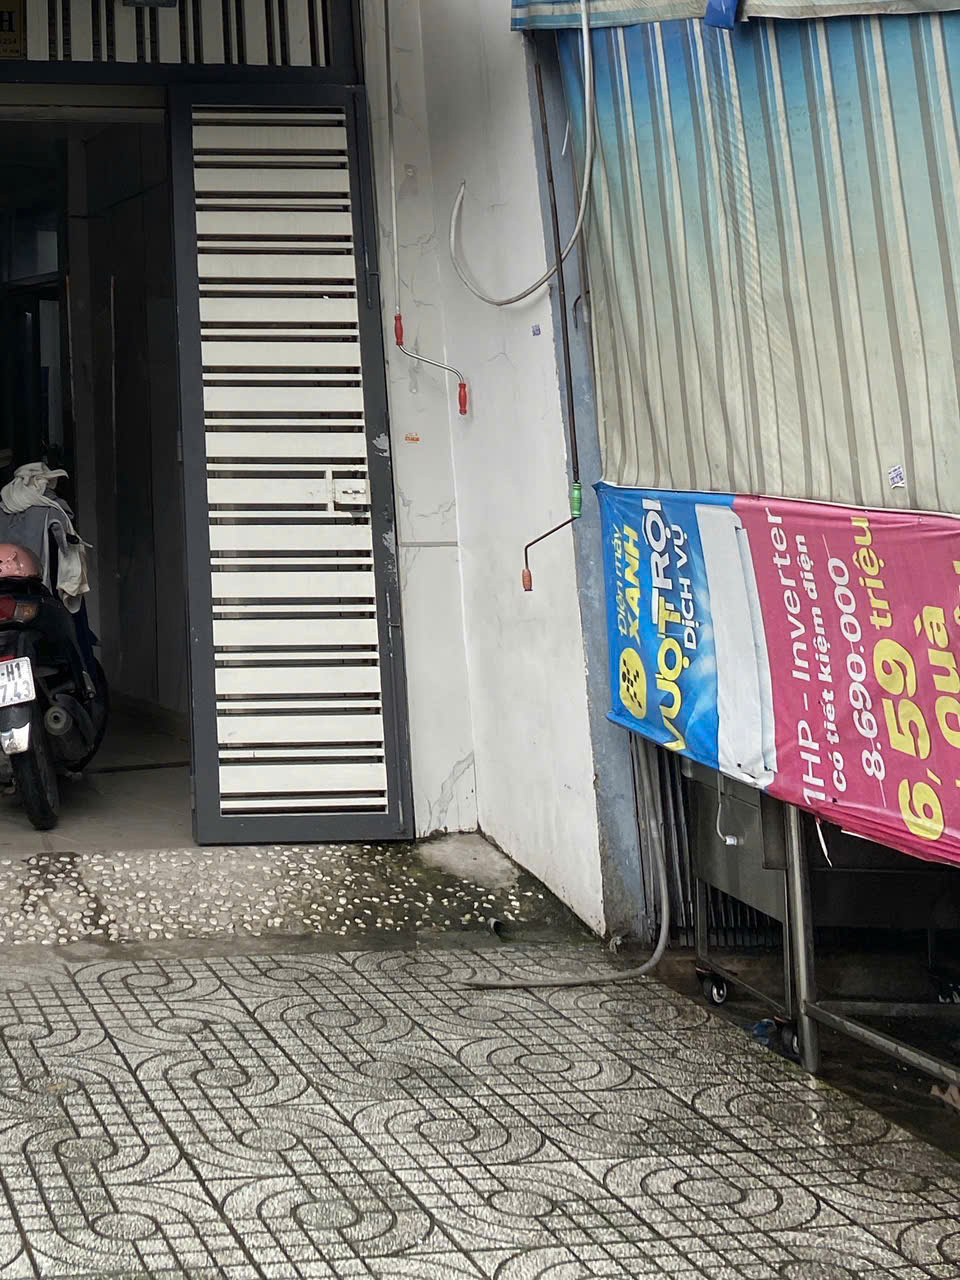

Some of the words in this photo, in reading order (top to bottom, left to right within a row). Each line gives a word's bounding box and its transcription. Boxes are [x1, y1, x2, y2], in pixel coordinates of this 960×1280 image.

[623, 524, 641, 648] XANH
[671, 523, 689, 568] VỤ
[795, 534, 819, 600] điện
[850, 515, 893, 630] triệu
[680, 577, 701, 650] DỊCH
[766, 507, 810, 681] Inverter
[809, 601, 834, 684] kiệm
[828, 557, 886, 780] 8.690.000
[817, 688, 840, 745] tiết
[872, 638, 945, 841] 6,59
[798, 720, 827, 806] 1HP
